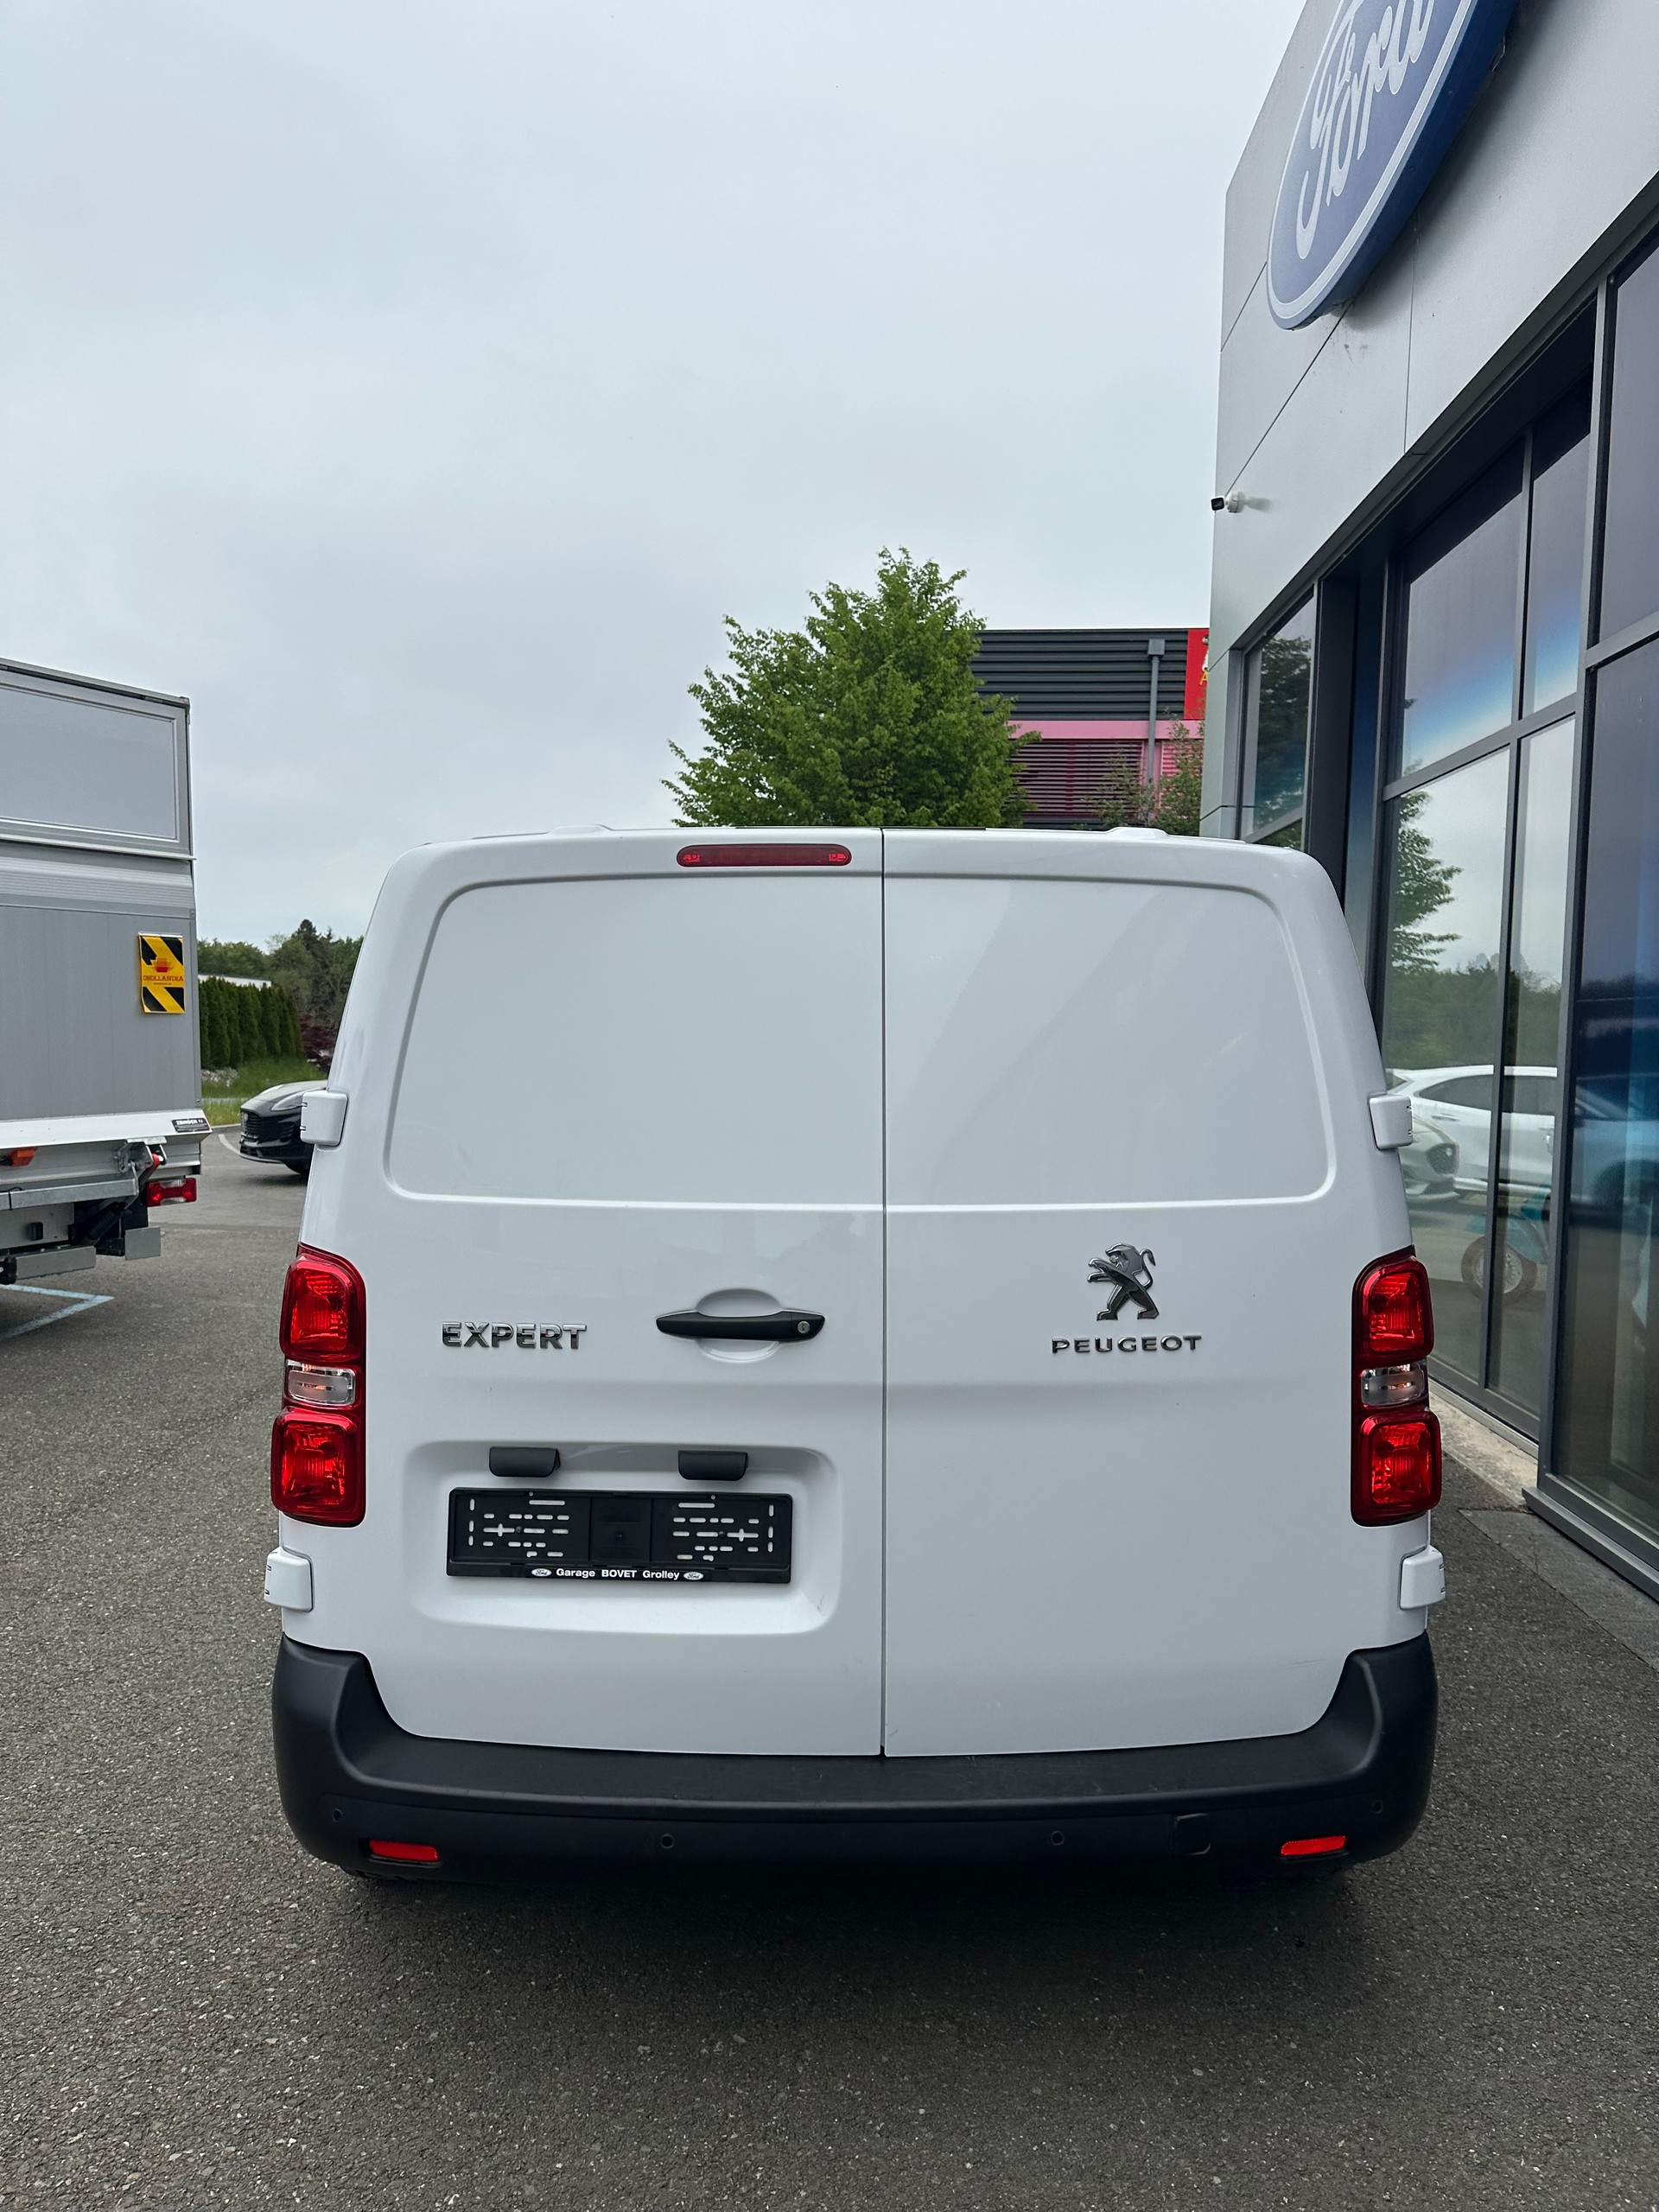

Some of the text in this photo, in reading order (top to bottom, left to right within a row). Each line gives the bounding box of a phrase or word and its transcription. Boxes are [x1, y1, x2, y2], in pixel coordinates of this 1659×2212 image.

[442, 1321, 588, 1350] EXPERT
[1052, 1335, 1202, 1353] PEUGEOT
[556, 1568, 595, 1579] Garage
[601, 1569, 637, 1579] BOVET
[642, 1570, 680, 1580] Grolley
